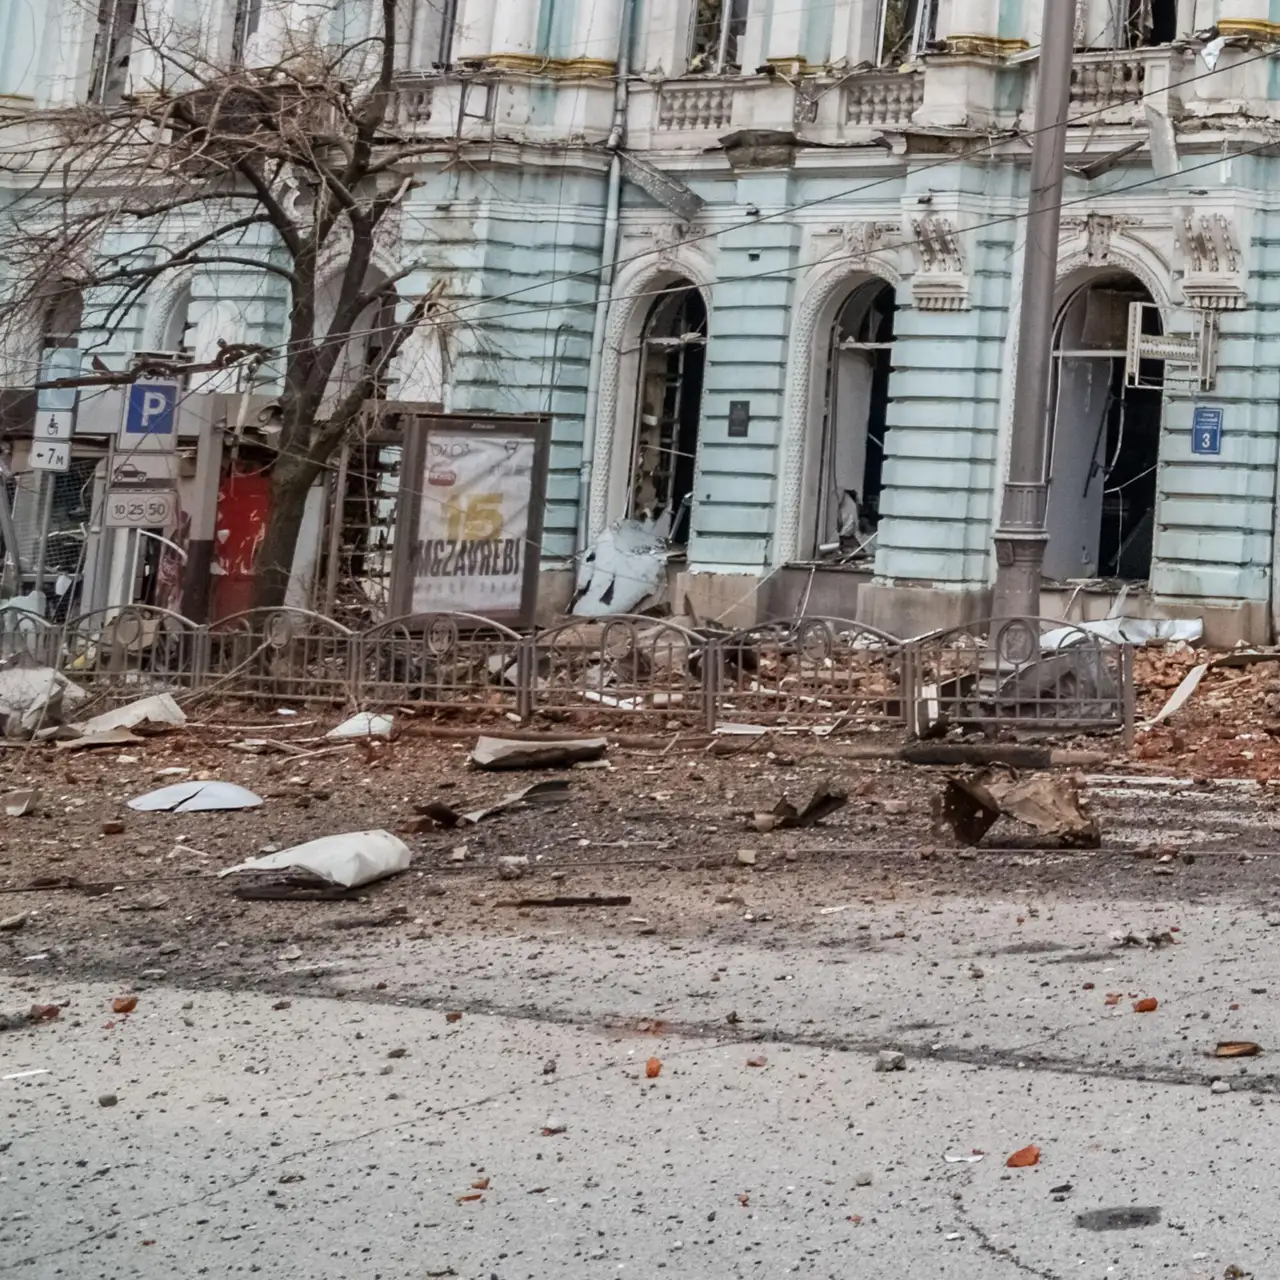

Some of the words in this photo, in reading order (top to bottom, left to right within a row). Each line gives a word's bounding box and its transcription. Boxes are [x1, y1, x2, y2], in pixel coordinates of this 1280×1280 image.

[140, 392, 167, 427] P
[1202, 433, 1210, 448] 3
[114, 504, 126, 515] 10
[128, 504, 145, 516] 25
[149, 503, 166, 516] 50
